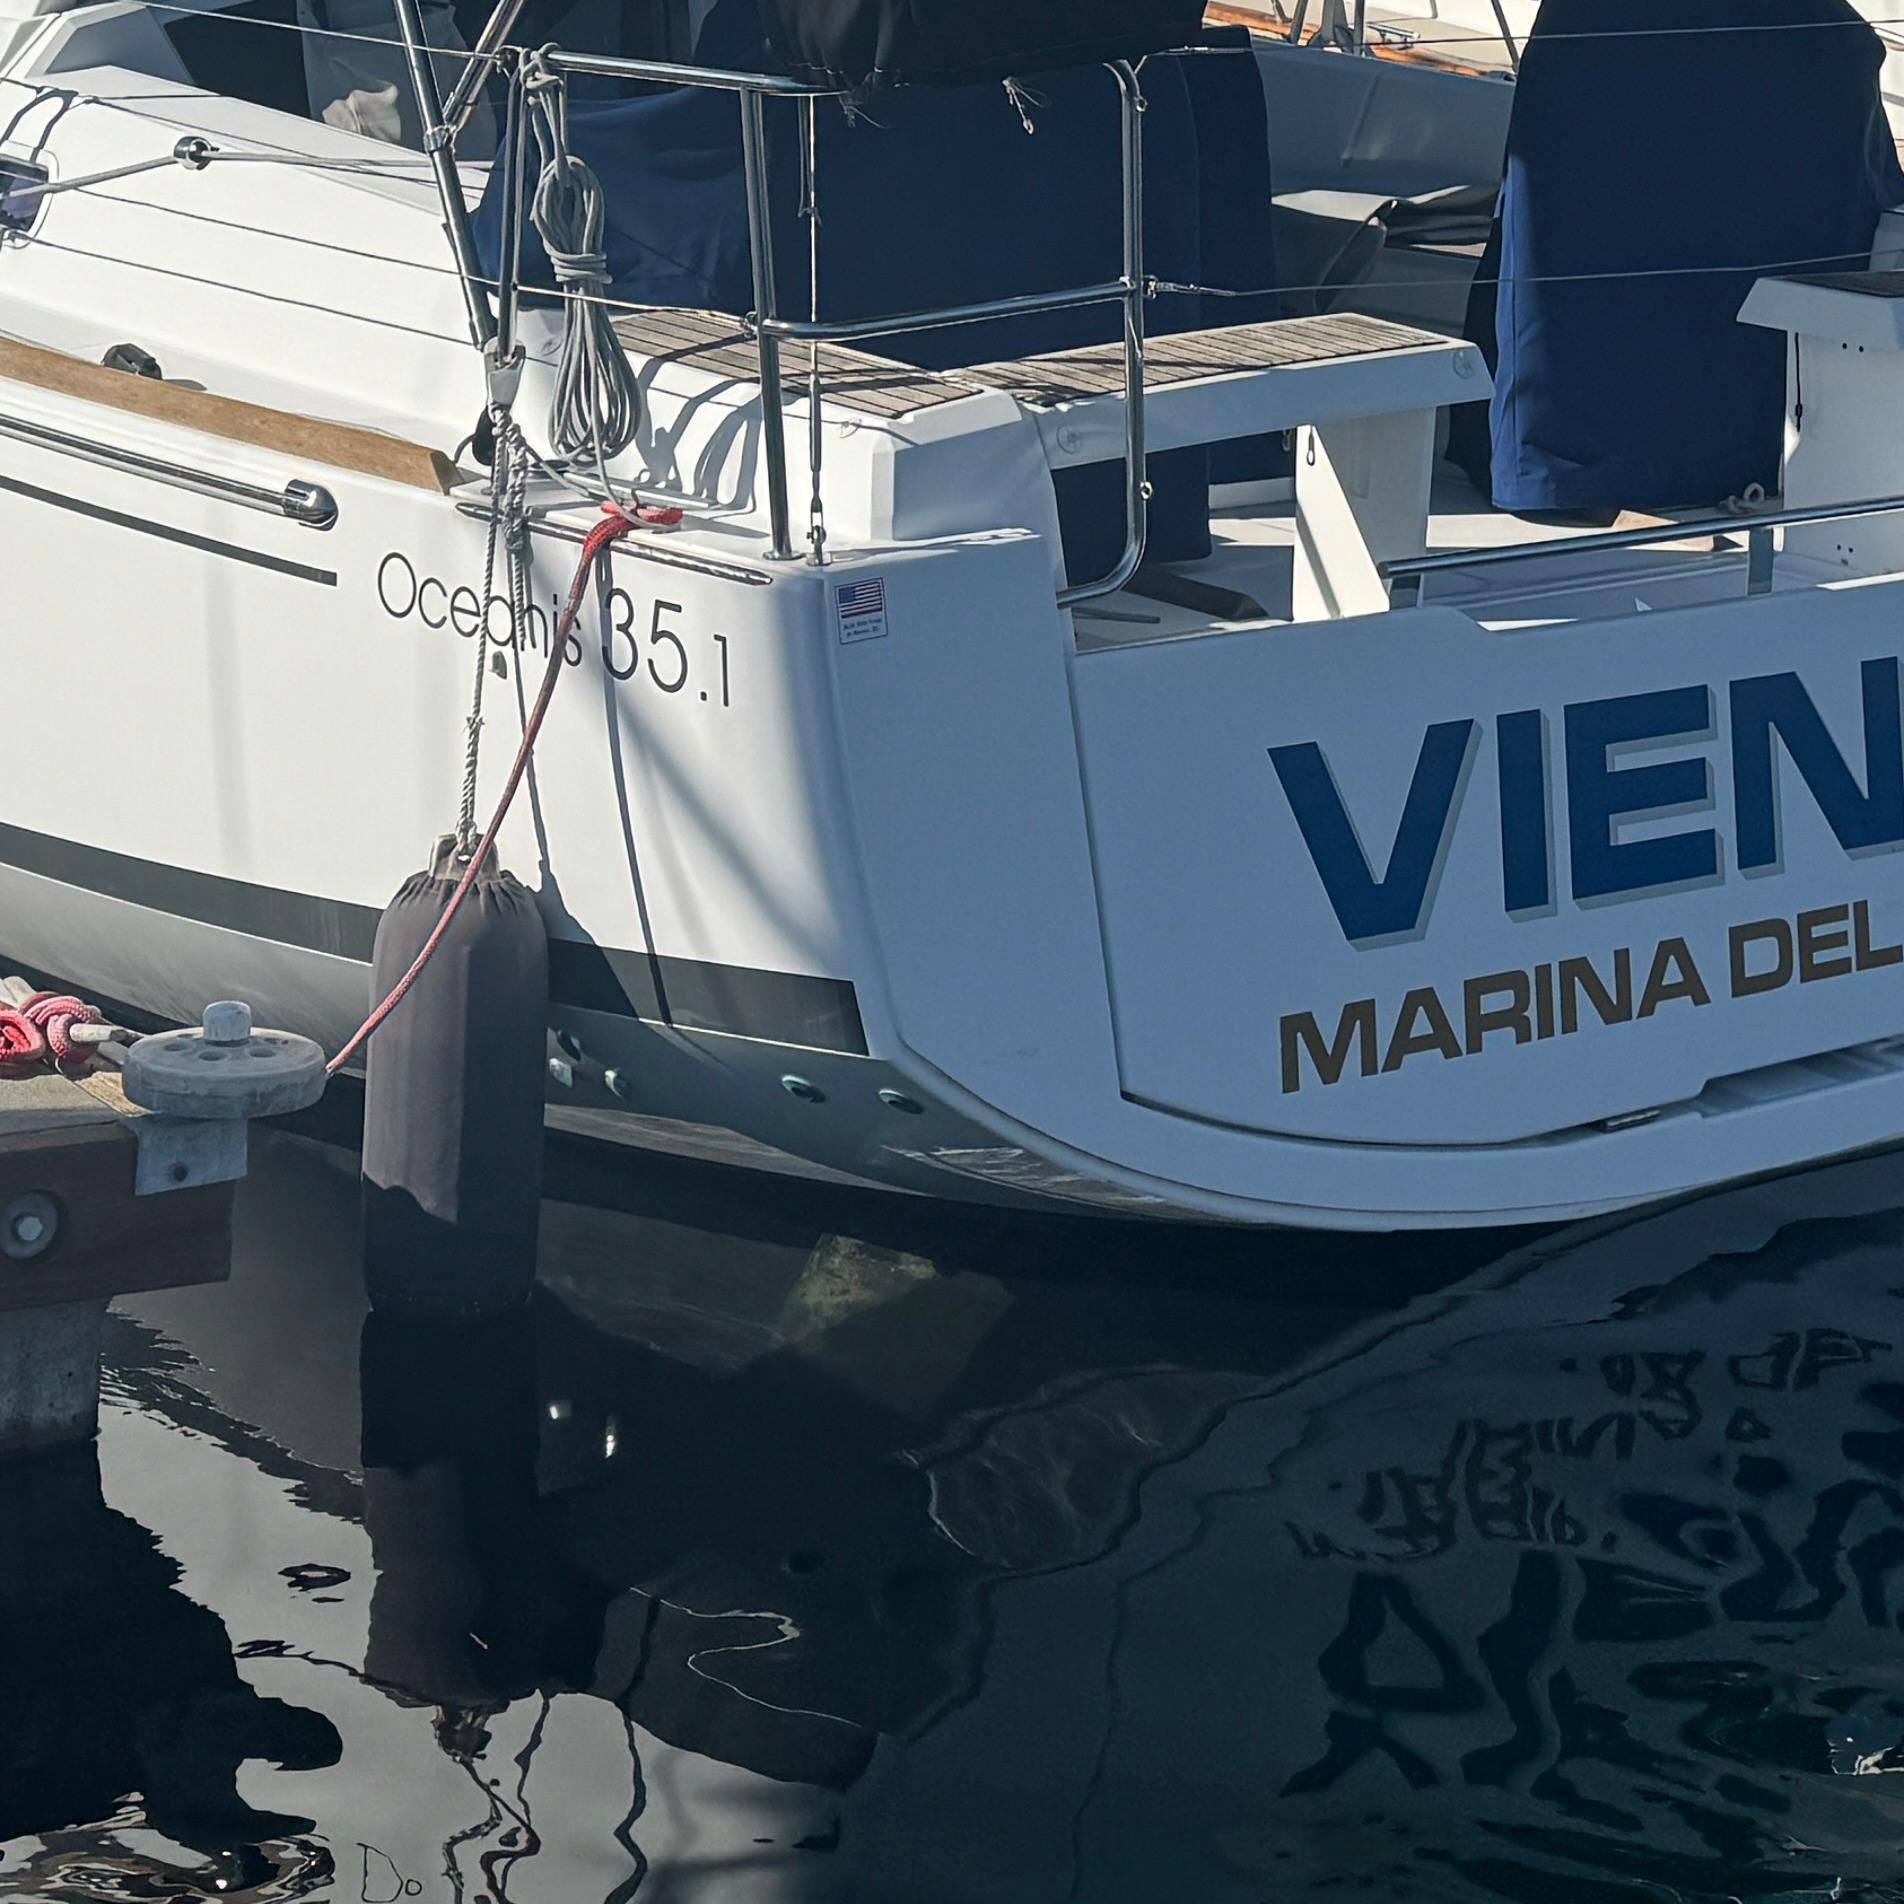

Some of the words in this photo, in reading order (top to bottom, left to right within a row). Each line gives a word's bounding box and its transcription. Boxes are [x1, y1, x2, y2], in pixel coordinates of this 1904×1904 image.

[377, 551, 584, 667] Oceanis
[601, 587, 730, 708] 35.1
[1278, 938, 1712, 1095] MARINA
[1729, 893, 1904, 1000] DEL
